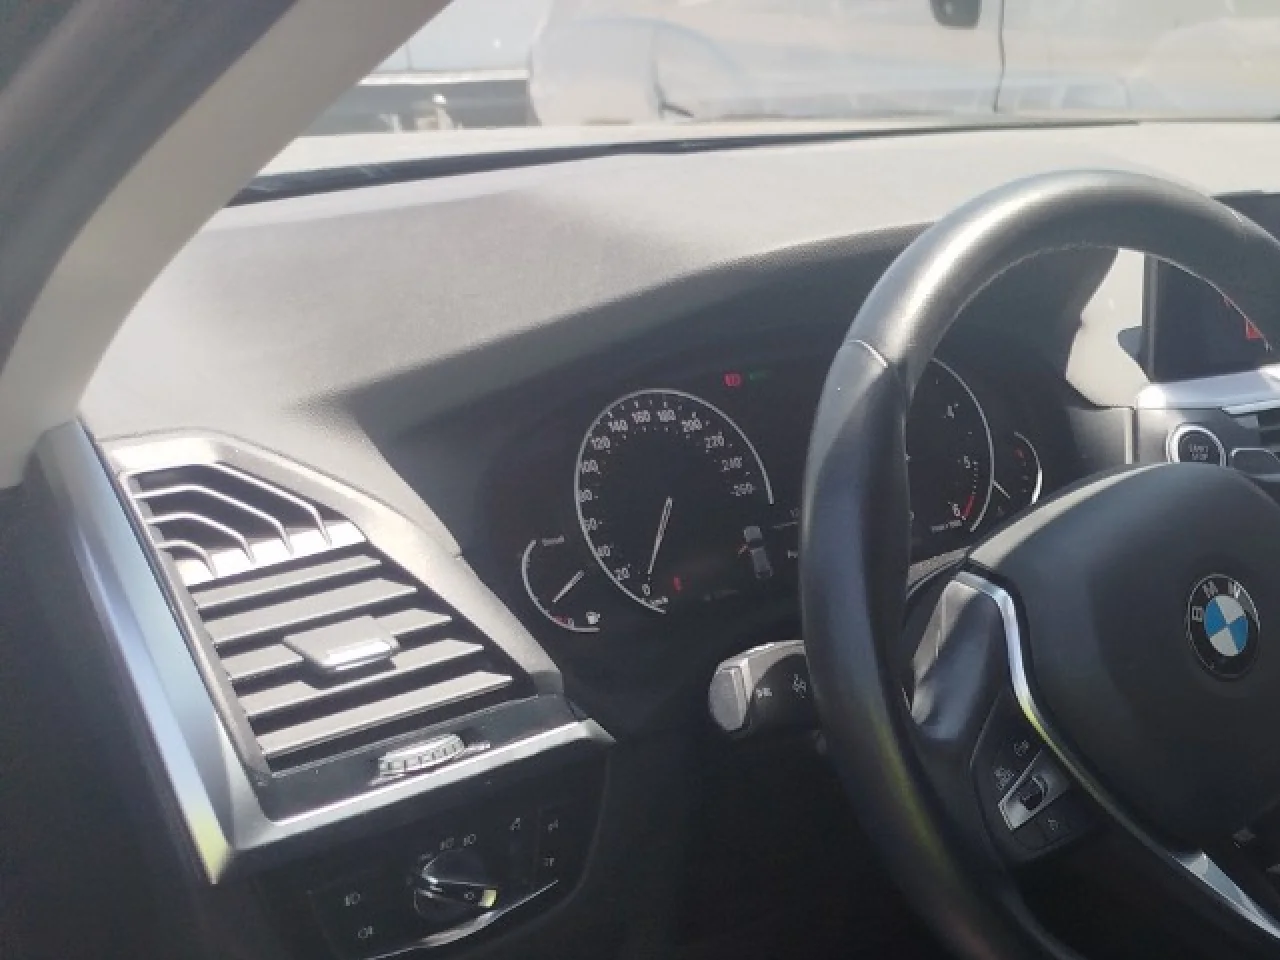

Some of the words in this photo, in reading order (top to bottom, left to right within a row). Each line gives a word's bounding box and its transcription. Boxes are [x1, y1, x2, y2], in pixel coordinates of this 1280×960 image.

[608, 419, 629, 432] 140
[681, 418, 703, 432] 200
[591, 436, 610, 450] 120
[703, 435, 725, 449] 220
[720, 456, 743, 472] 240
[951, 503, 961, 517] 6
[641, 583, 651, 597] 0
[1191, 579, 1243, 622] BMW
